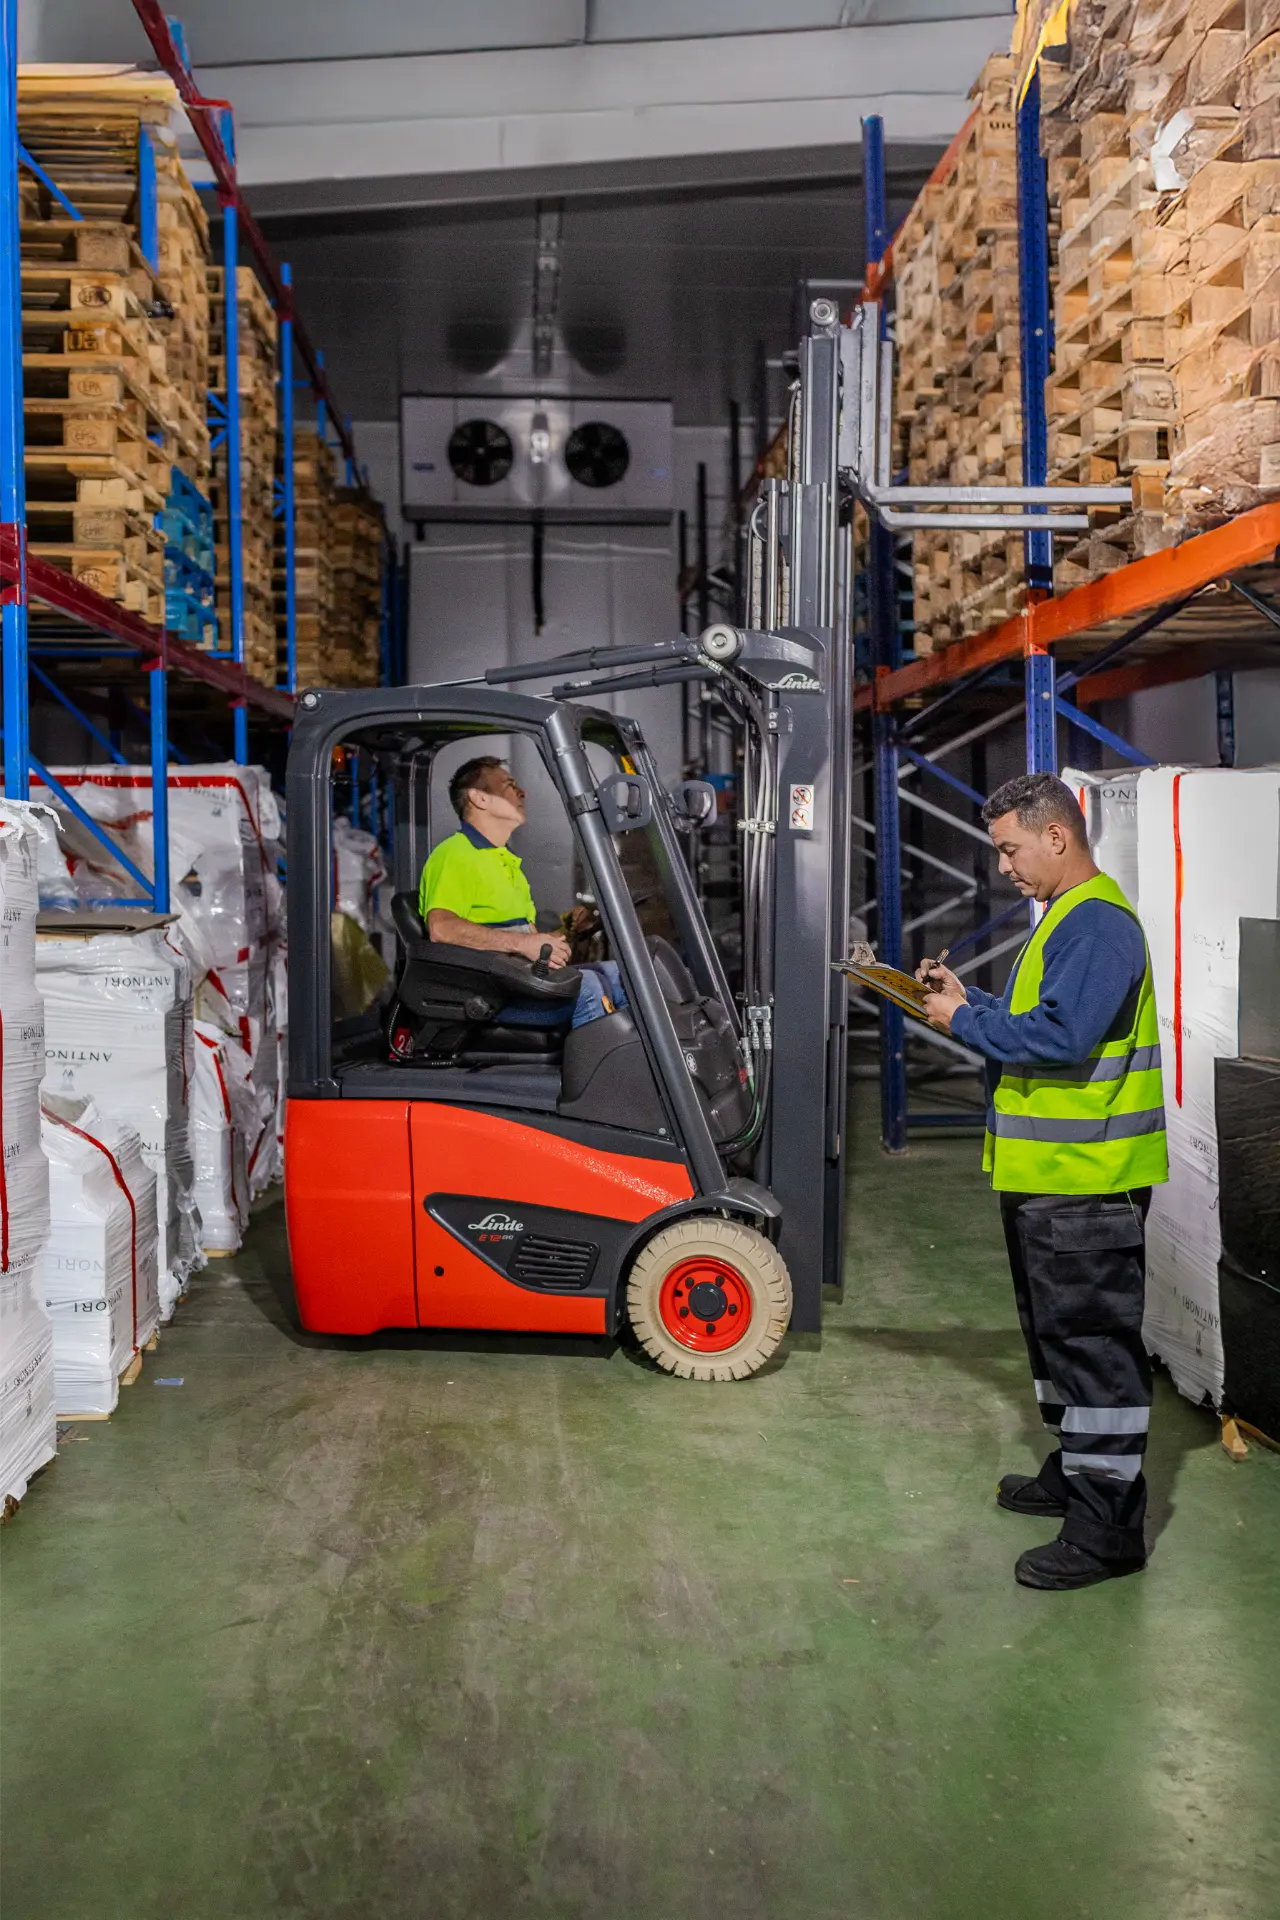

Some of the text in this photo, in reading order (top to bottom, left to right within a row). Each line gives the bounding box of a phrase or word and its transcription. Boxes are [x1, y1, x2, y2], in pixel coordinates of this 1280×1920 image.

[768, 672, 820, 690] Linde
[105, 975, 171, 987] ANTINORI
[44, 1049, 112, 1062] ANTINO
[467, 1213, 524, 1231] Linde
[1182, 1295, 1219, 1329] ANTINORI
